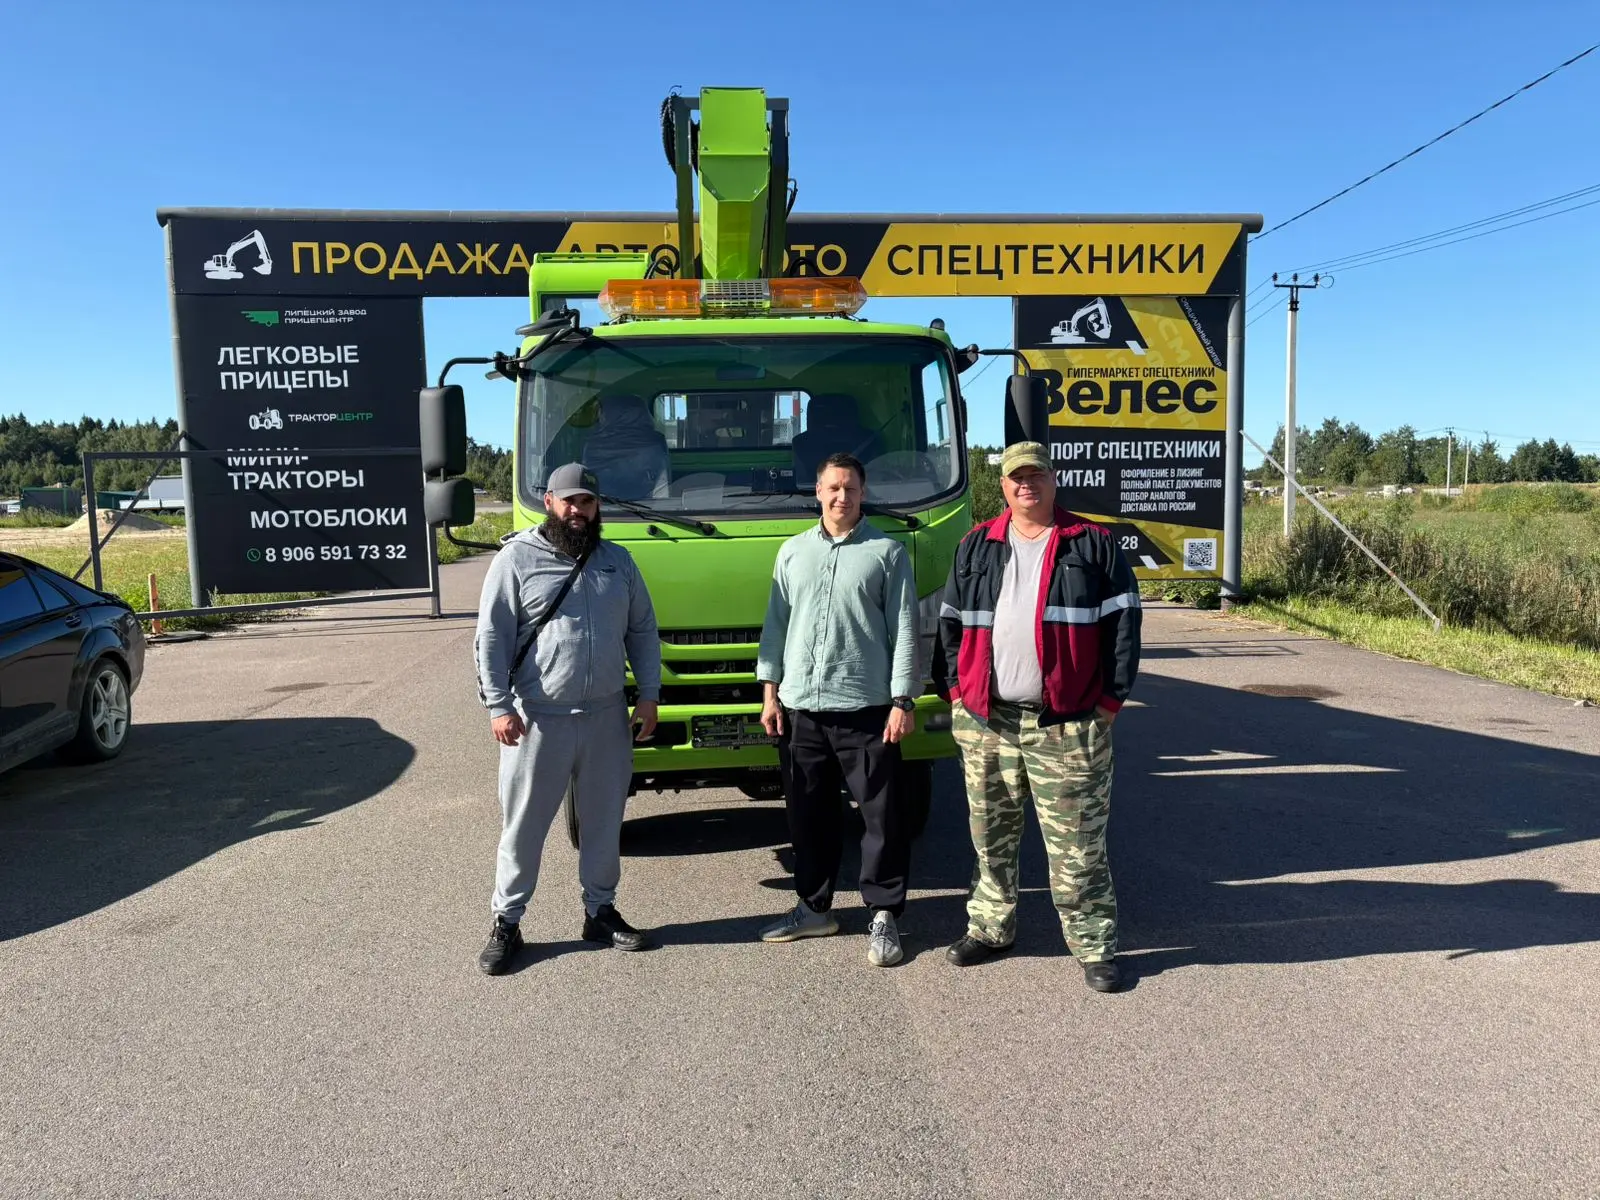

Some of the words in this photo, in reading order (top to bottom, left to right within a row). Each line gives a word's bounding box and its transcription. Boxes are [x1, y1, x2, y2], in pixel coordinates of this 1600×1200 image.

[292, 241, 531, 281] ПРОДАЖА
[887, 244, 1206, 281] СПЕЦТЕХНИКИ
[284, 308, 335, 317] ЛИПЕЦКИЙ
[217, 345, 360, 366] ЛЕГКОВЫЕ
[220, 370, 349, 393] ПРИЦЕПЫ
[1067, 367, 1139, 378] ГИПЕРМАРКЕТ
[1143, 367, 1215, 379] СПЕЦТЕХНИКИ
[1031, 368, 1218, 415] Велес
[287, 412, 373, 422] ТРАКТОРЦЕНТР
[226, 447, 309, 466] МИНИ-
[1050, 442, 1094, 460] ПОРТ
[1098, 441, 1220, 460] СПЕЦТЕХНИКИ
[227, 470, 365, 490] ТРАКТОРЫ
[1120, 468, 1169, 478] ОФОРМЛЕНИЕ
[1170, 468, 1176, 477] В
[1176, 468, 1204, 477] ЛИЗИНГ
[1120, 479, 1151, 489] ПОЛНЫЙ
[1152, 480, 1174, 489] ПАКЕТ
[1175, 479, 1222, 489] ДОКУМЕНТОВ
[1120, 492, 1149, 501] ПОДБОР
[1149, 491, 1187, 500] АНАЛОГОВ
[1120, 502, 1157, 513] ДОСТАВКА
[1158, 502, 1168, 511] ПО
[1169, 502, 1196, 511] РОССИИ
[250, 507, 408, 529] МОТОБЛОКИ
[265, 548, 277, 562] 8
[282, 547, 315, 561] 906
[320, 546, 354, 560] 591
[358, 545, 380, 559] 73
[385, 545, 408, 559] 32
